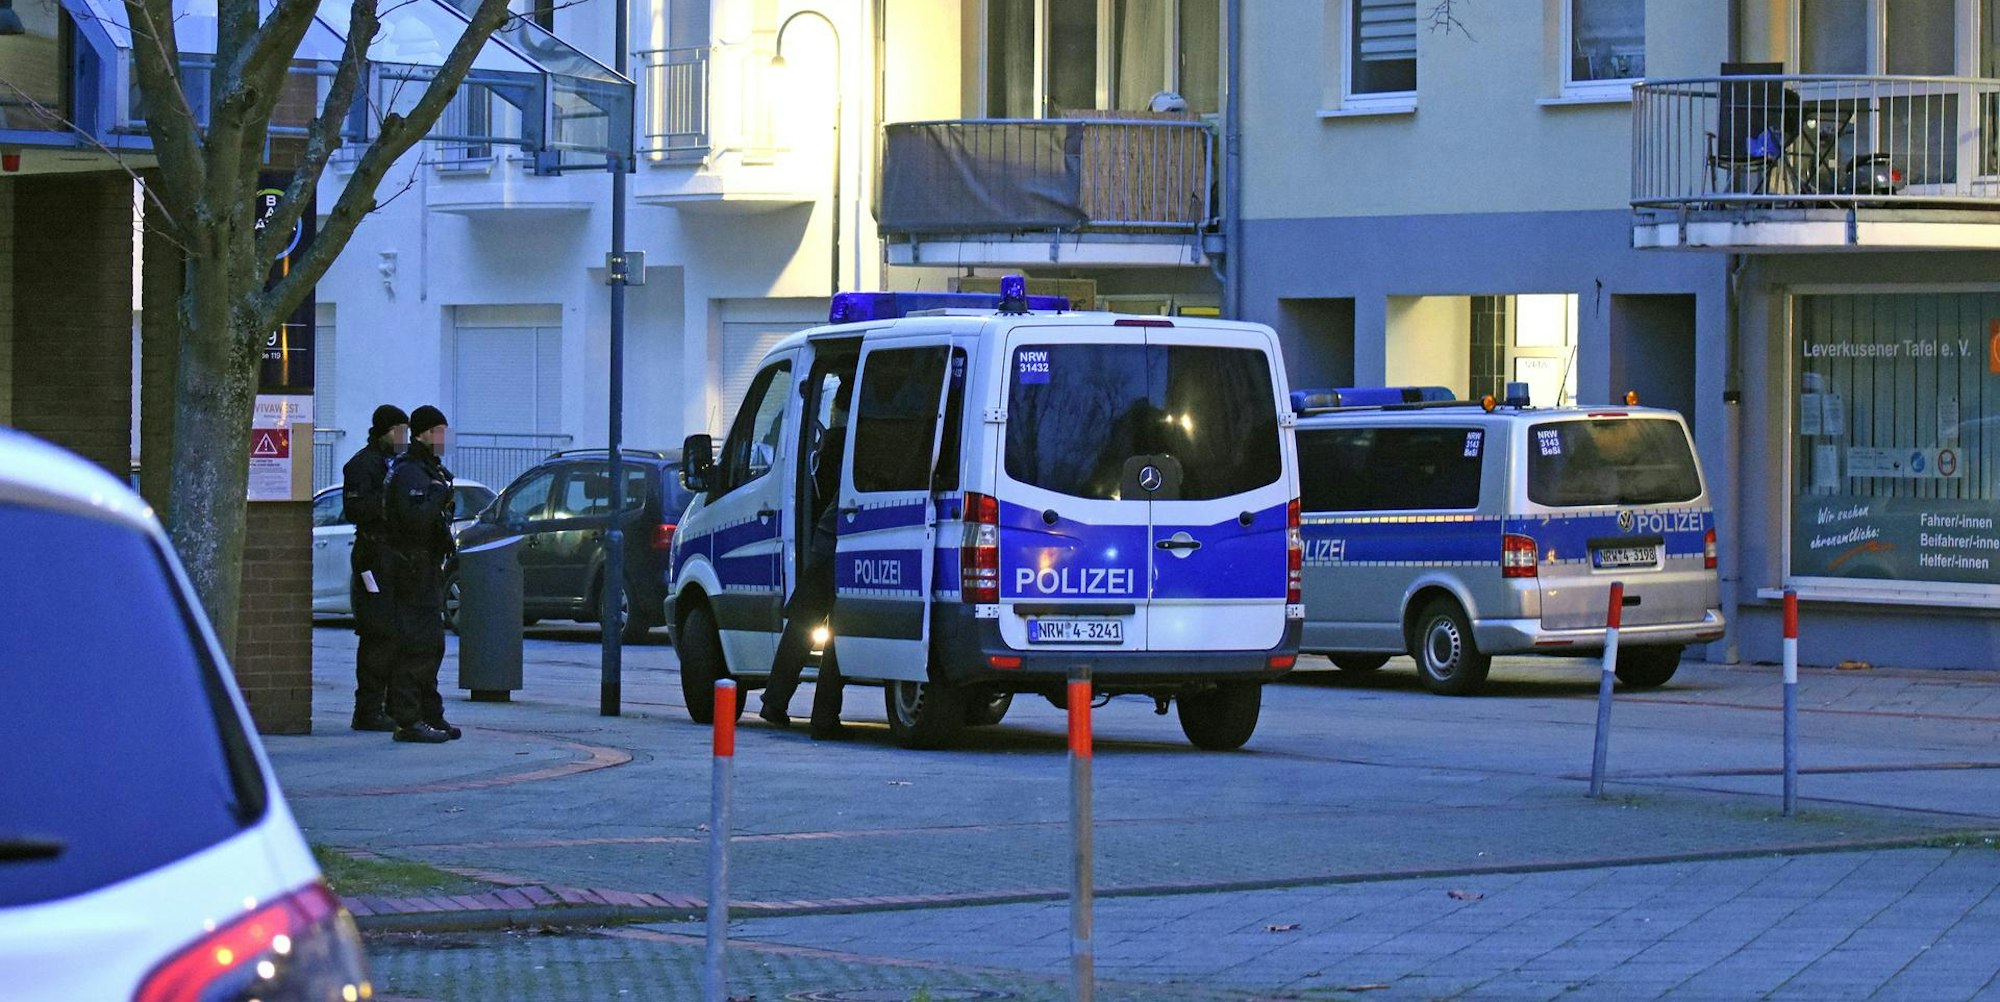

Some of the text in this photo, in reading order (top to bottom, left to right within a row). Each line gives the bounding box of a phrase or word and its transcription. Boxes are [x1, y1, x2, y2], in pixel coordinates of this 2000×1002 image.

[1020, 351, 1048, 362] NRW
[1803, 340, 1972, 358] Leverkusener Tafel e. V.
[1020, 362, 1049, 373] 31432
[1537, 429, 1558, 440] NRW
[1540, 438, 1560, 448] 3143
[1817, 503, 1869, 525] Wir suchen
[1920, 512, 1993, 529] Fahrer/-innen
[1636, 512, 1704, 534] POLIZEI
[1600, 546, 1656, 562] NRW 4-3198
[1920, 552, 1989, 569] Helfer/-innen
[854, 559, 901, 585] POLIZEI
[1015, 567, 1134, 594] POLIZEI
[1038, 622, 1120, 639] NRW 4-3241
